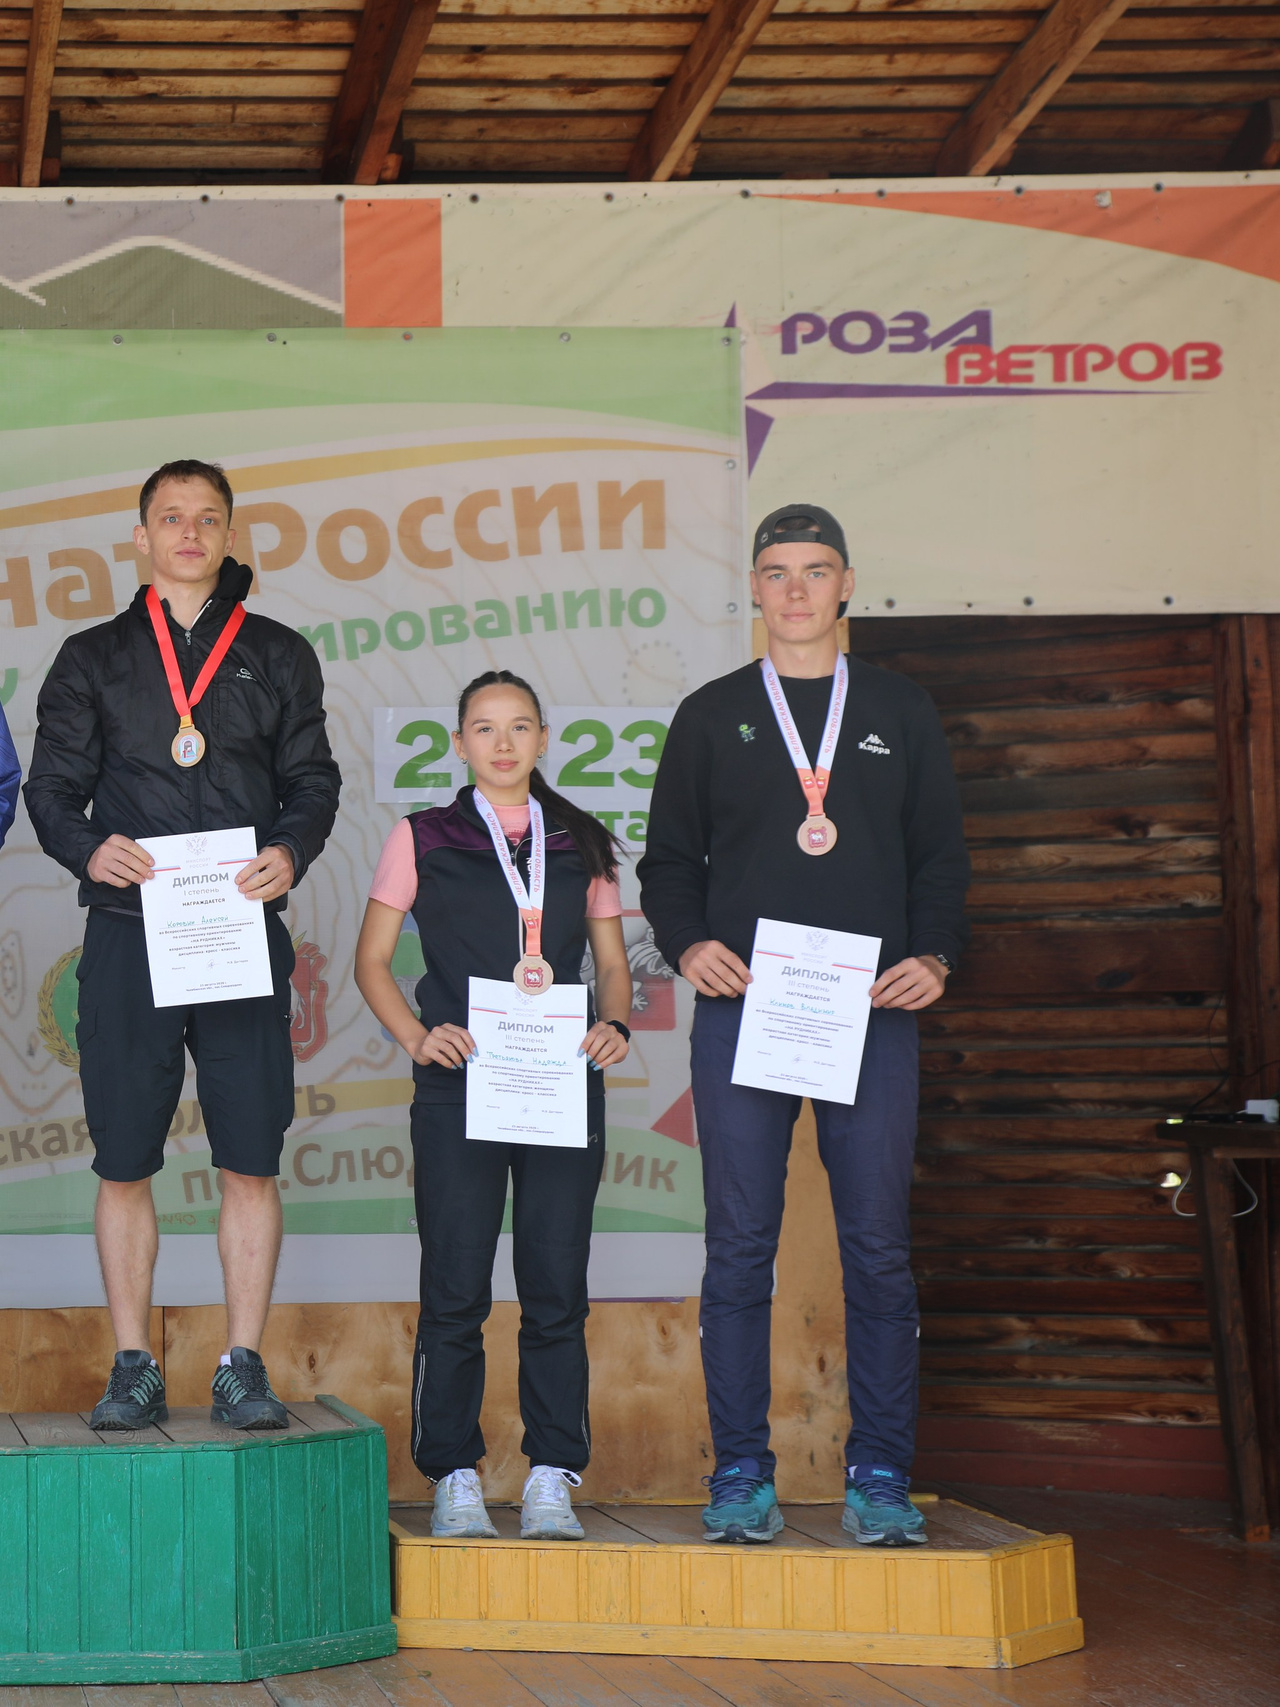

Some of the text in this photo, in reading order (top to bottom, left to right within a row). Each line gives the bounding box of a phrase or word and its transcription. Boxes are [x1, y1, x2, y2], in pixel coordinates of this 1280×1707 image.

[781, 309, 993, 355] РОЗА
[945, 341, 1224, 386] ВЕТРОВ
[393, 718, 670, 789] 223
[858, 741, 891, 755] Kappa
[172, 872, 229, 888] ДИПЛОМ
[188, 887, 219, 895] степень
[182, 898, 225, 906] НАГРАЖДАЕТСЯ
[781, 965, 841, 984] ДИПЛОМ
[797, 982, 830, 992] степень
[786, 991, 830, 1002] НАГРАЖДАЕТСЯ
[498, 1021, 554, 1034] ДИПЛОМ
[514, 1036, 545, 1044] степень
[505, 1045, 547, 1053] НАГРАЖДАЕТСЯ
[872, 1469, 894, 1478] HOKA
